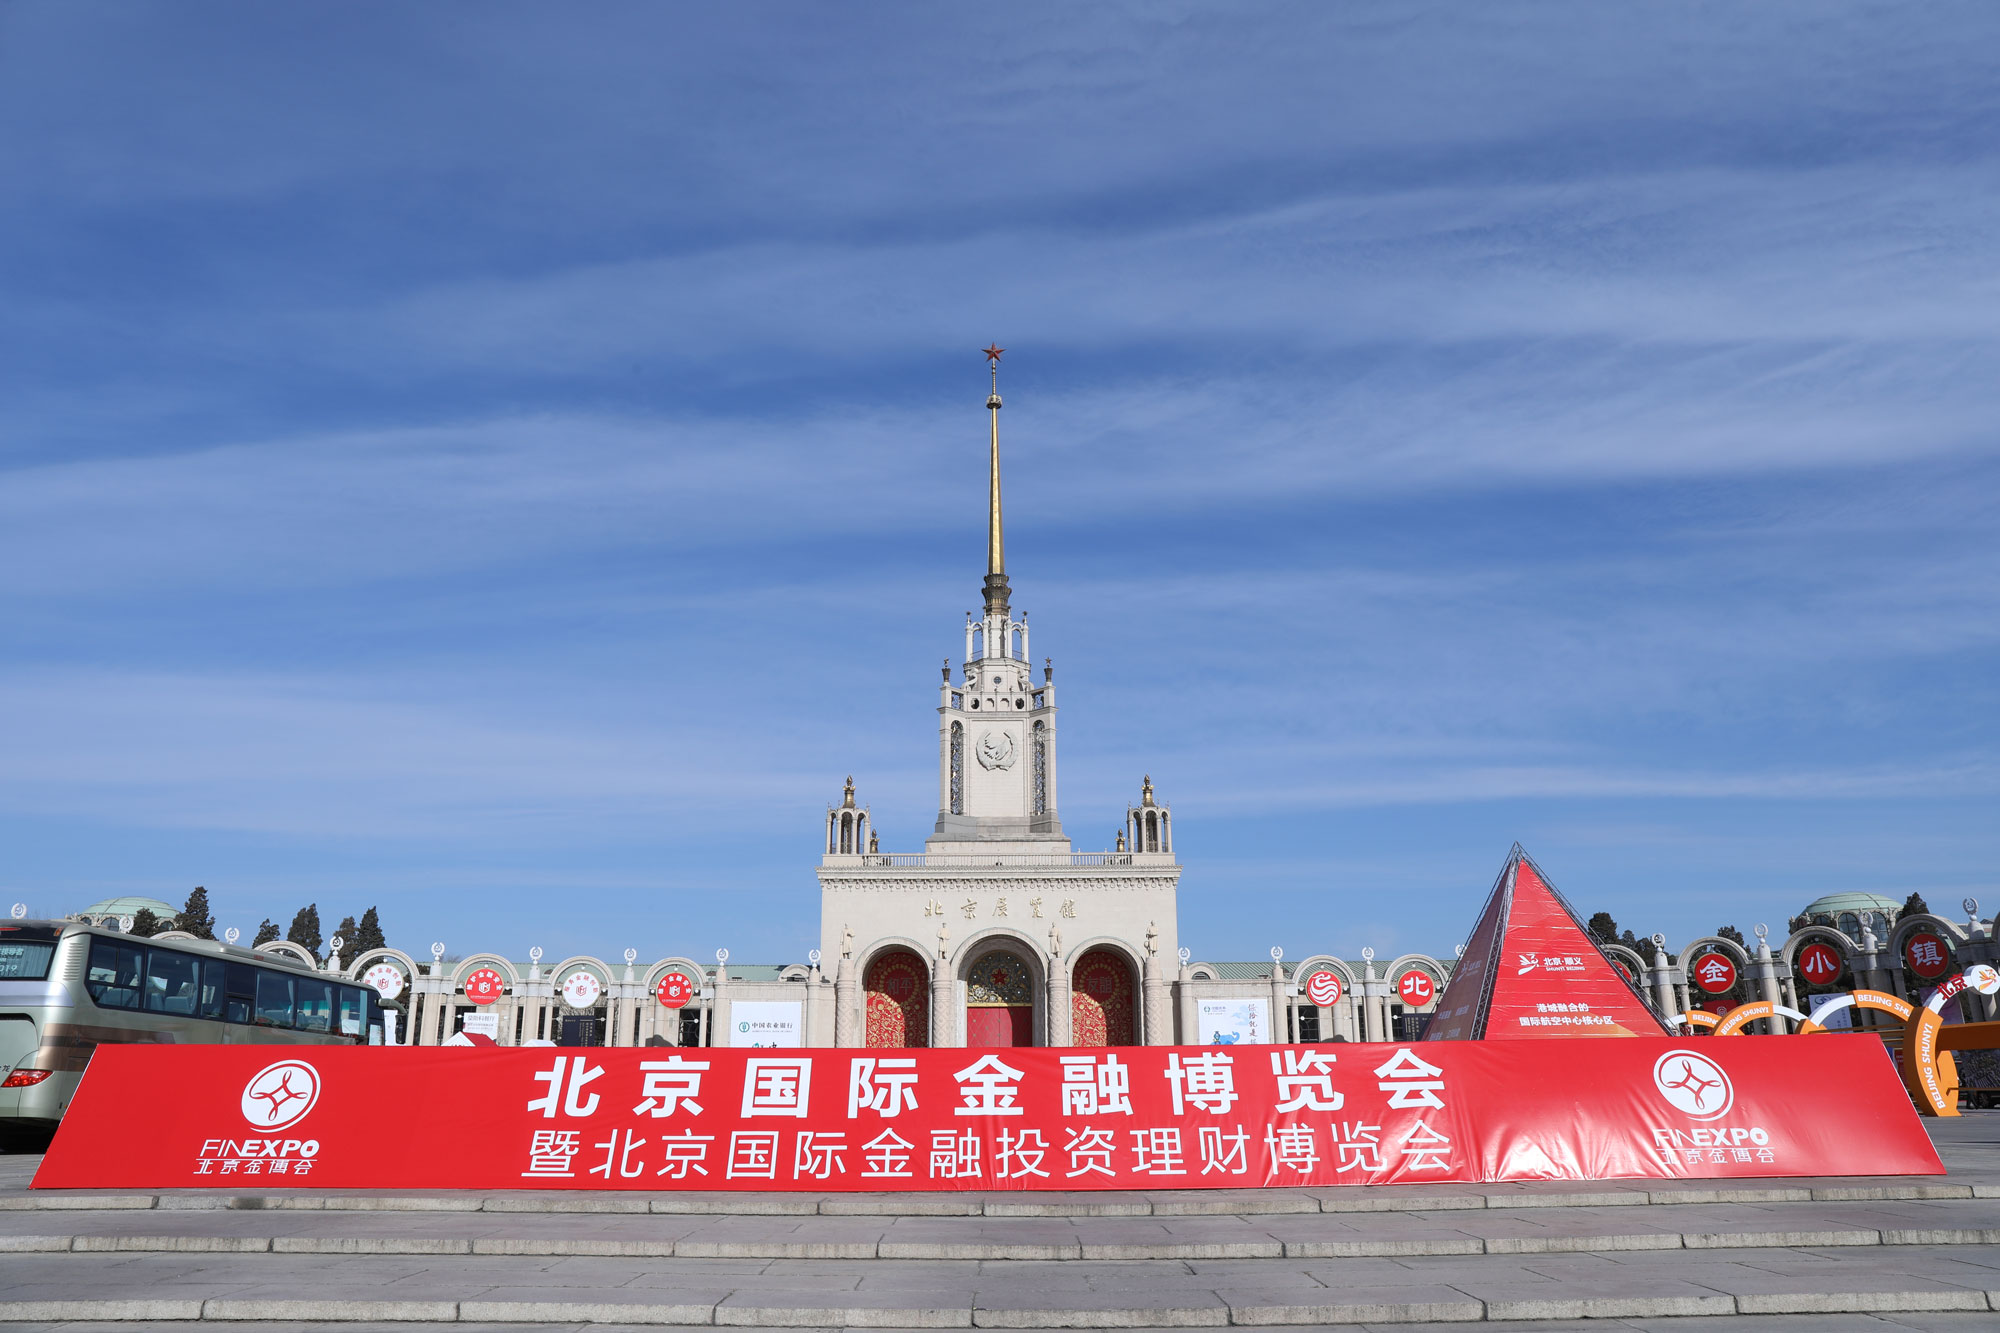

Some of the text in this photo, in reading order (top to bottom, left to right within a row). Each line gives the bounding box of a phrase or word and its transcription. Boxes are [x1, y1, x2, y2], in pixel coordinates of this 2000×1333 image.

[1805, 951, 1837, 974] 小
[1911, 941, 1943, 966] 镇
[1700, 959, 1729, 983] 金
[1403, 976, 1430, 997] 北
[1936, 972, 1968, 1001] 北京
[1857, 994, 1893, 1007] BEIJING
[1720, 1006, 1769, 1035] BEIJING SHUNYI
[1922, 1022, 1946, 1109] BEIJING SHUNYI
[527, 1049, 1446, 1119] 北京国际金融博览会
[199, 1139, 320, 1158] FINEXPO
[1653, 1127, 1769, 1147] FINEXPO
[520, 1119, 1452, 1180] 暨北京国际金融投资理财博览会
[1659, 1148, 1775, 1165] 北京金博会
[193, 1159, 313, 1175] 北京金博会
